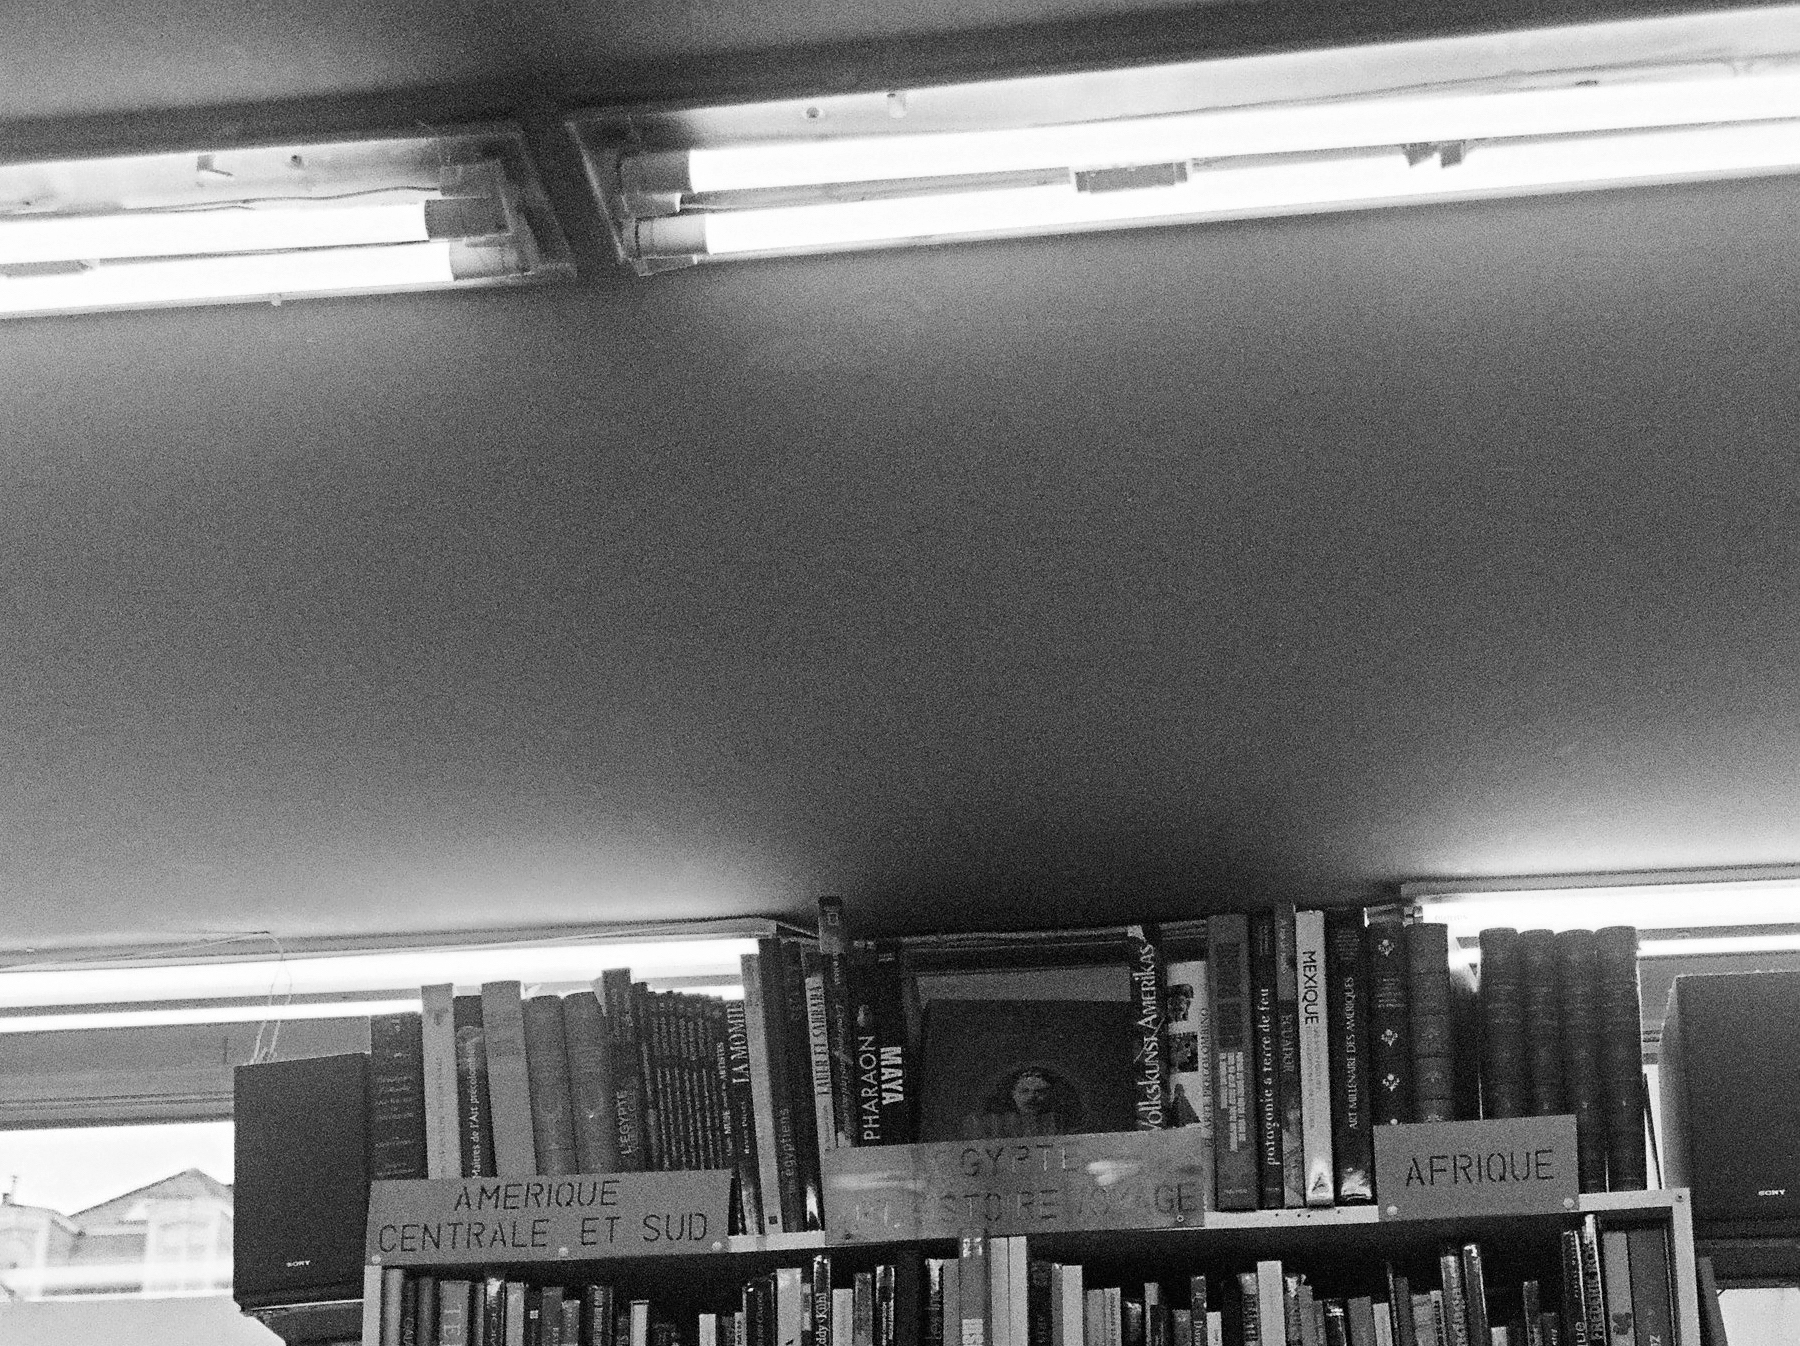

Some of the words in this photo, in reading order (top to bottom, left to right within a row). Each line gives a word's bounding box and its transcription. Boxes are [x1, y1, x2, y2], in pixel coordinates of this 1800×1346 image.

[1256, 988, 1270, 1011] feu
[1302, 950, 1318, 1025] MEXIQUE
[1258, 1015, 1270, 1032] de
[1260, 1036, 1273, 1072] terre
[1346, 1034, 1356, 1053] DES
[731, 1064, 750, 1084] LA
[857, 1035, 880, 1141] PHARAON
[880, 1046, 904, 1106] MAYA
[1260, 1089, 1280, 1165] patagonie
[1348, 1111, 1358, 1130] ART
[1405, 1149, 1555, 1188] AFRIQUE
[454, 1180, 621, 1211] AMERIQUE
[378, 1219, 551, 1252] CENTRALE
[580, 1216, 621, 1247] ET
[642, 1213, 709, 1243] SUD
[286, 1260, 311, 1268] SONY
